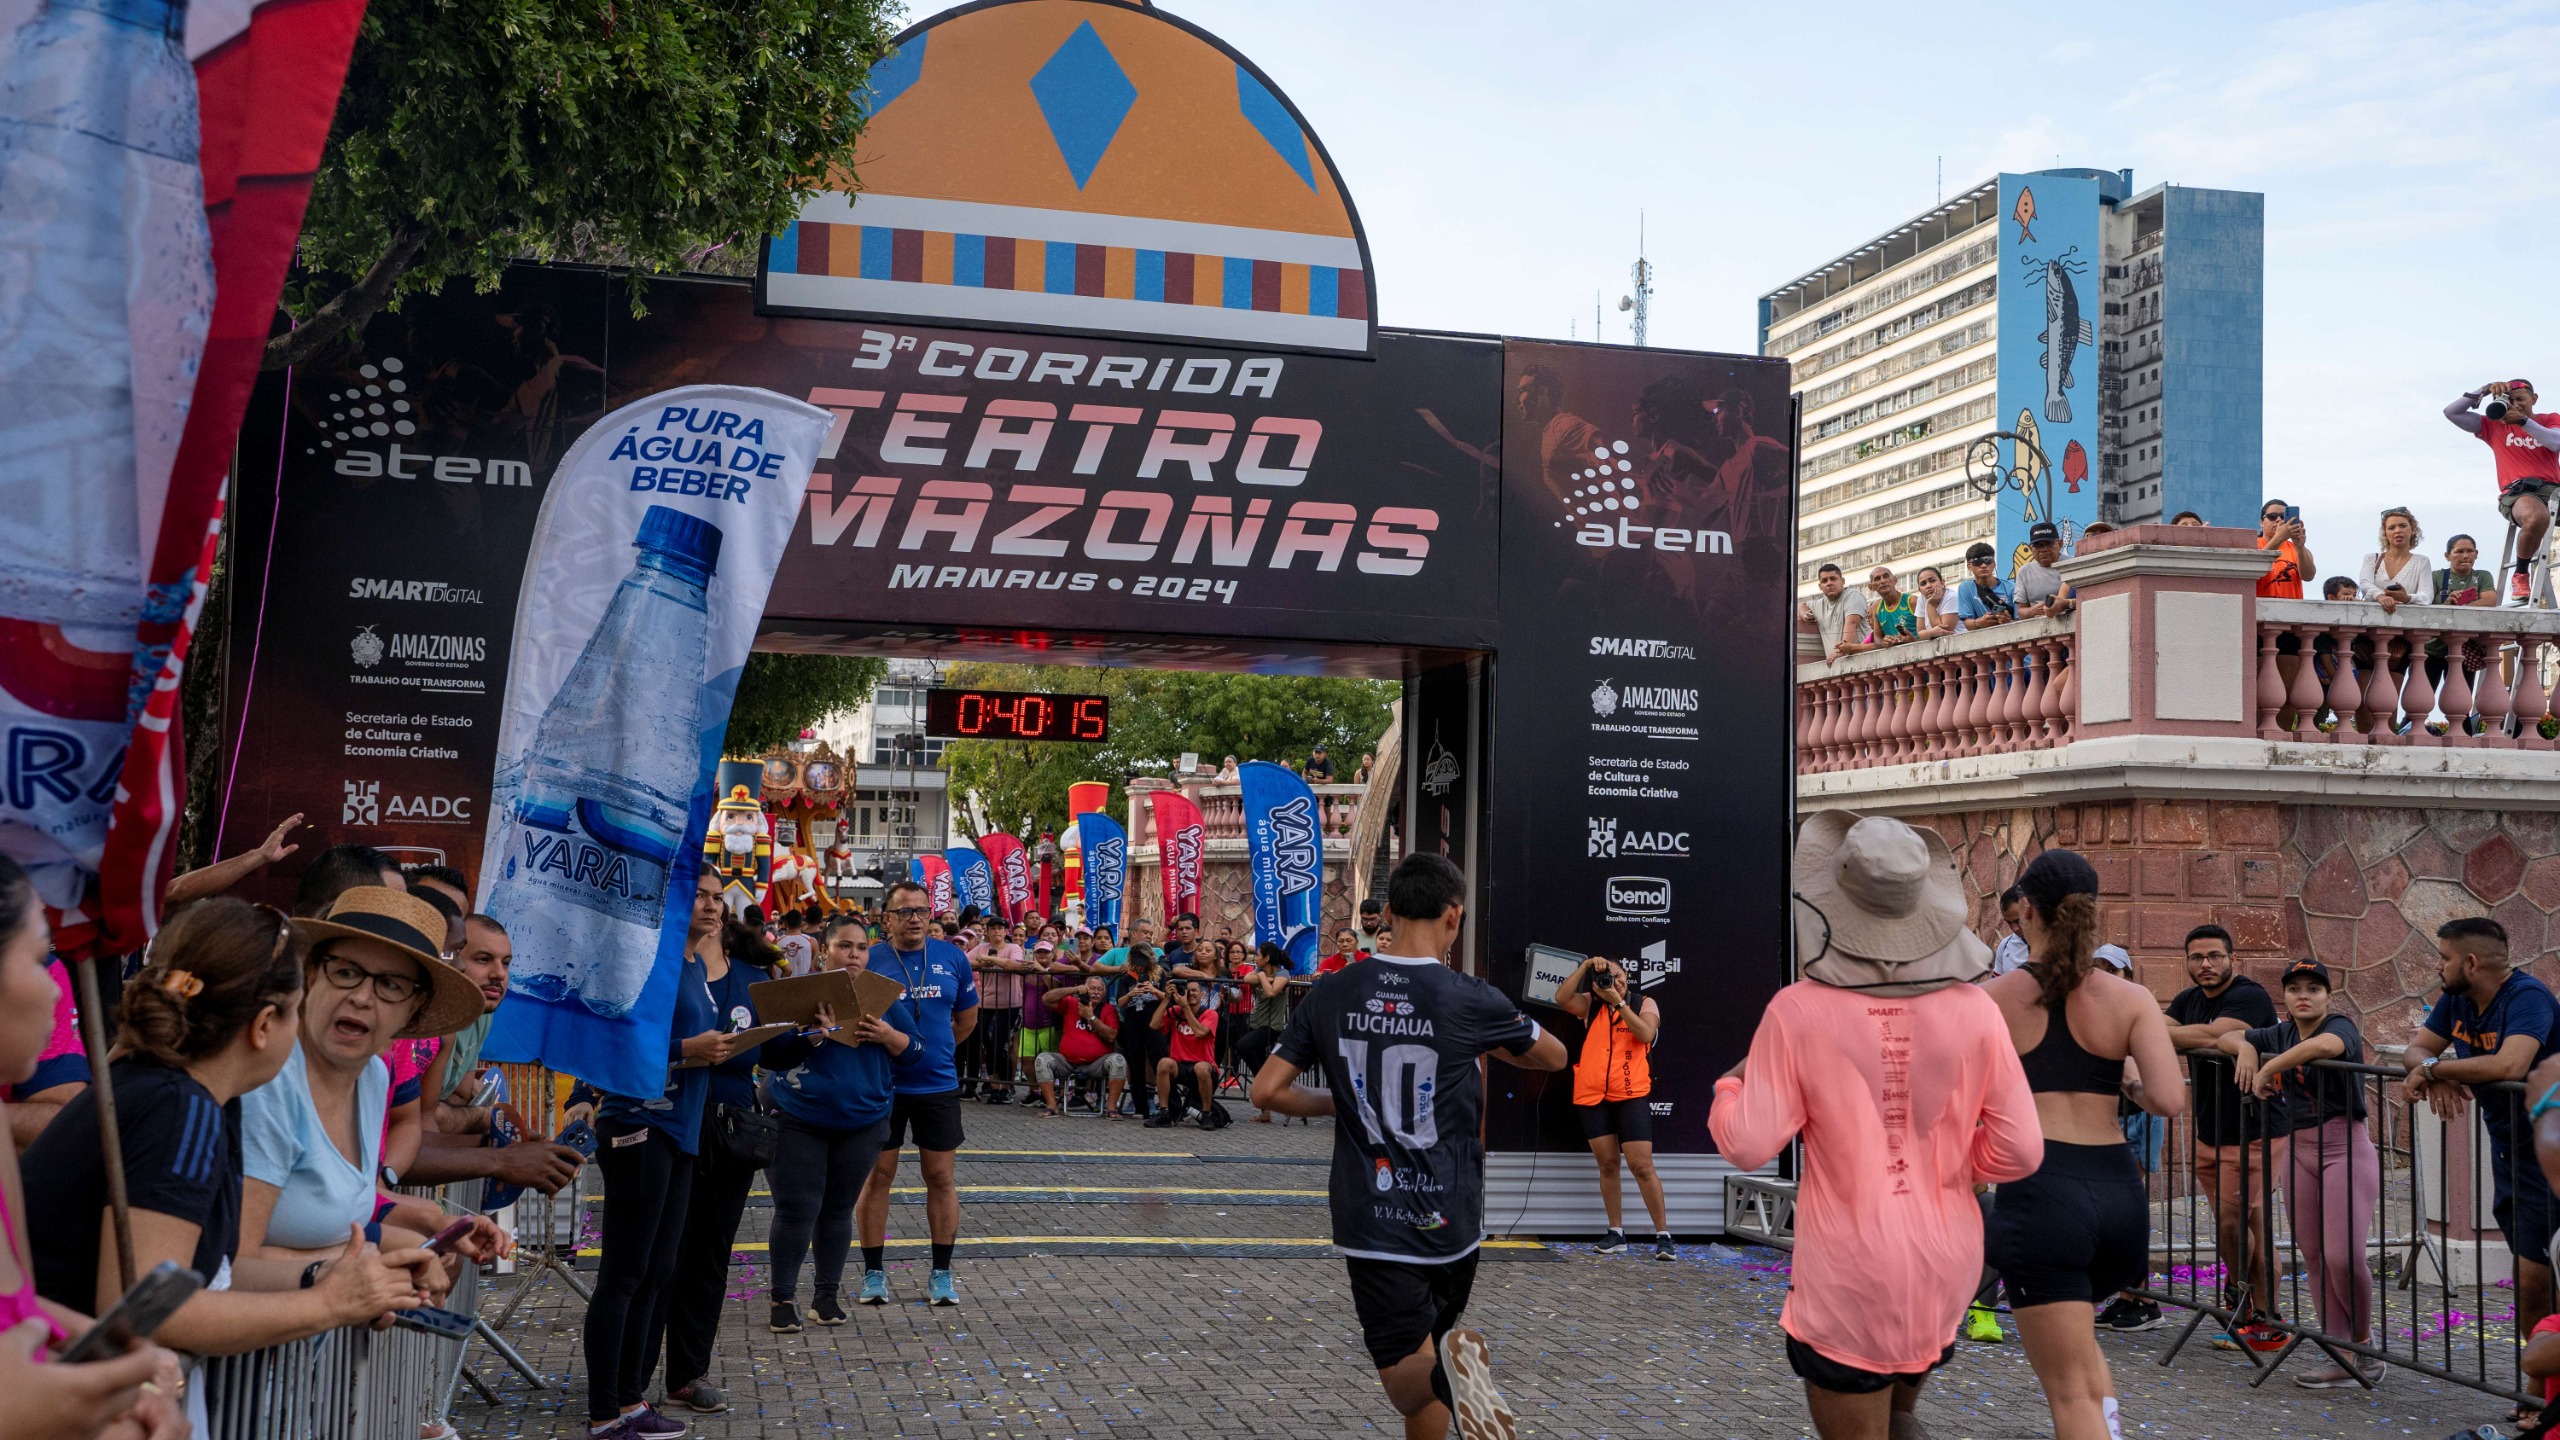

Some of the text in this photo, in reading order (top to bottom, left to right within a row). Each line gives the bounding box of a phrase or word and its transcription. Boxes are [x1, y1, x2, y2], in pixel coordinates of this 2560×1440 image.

[918, 340, 1284, 398] CORRIDA
[656, 406, 764, 445] PURA
[807, 386, 1323, 487] TEATRO
[334, 443, 533, 487] atem
[608, 426, 786, 480] ÁGUA DE
[630, 466, 752, 504] BEBER
[801, 473, 1440, 576] MAZONAS
[1576, 517, 1733, 554] atem
[888, 563, 1238, 604] MANAUS 2024
[389, 633, 486, 662] AMAZONAS
[350, 675, 485, 689] TRABALHO QUE TRANSFORMA
[1621, 686, 1699, 712] AMAZONAS
[346, 711, 473, 727] Secretaria de Estado
[1591, 723, 1699, 735] TRABALHO QUE TRANSFORMA
[345, 728, 422, 742] de Cultura e
[344, 744, 459, 759] Economia Criativa
[1588, 755, 1690, 770] Secretaria de Estado
[1588, 770, 1650, 783] de Cultura e
[1588, 785, 1679, 799] Economia Criativa
[385, 795, 471, 818] AADC
[1271, 798, 1317, 896] YARA
[1621, 830, 1690, 852] AADC
[524, 829, 632, 900] YARA
[1088, 850, 1096, 873] água
[1097, 838, 1123, 902] YARA
[1004, 849, 1029, 905] YARA
[1166, 838, 1178, 913] ÁGUA MINERAL
[1257, 819, 1278, 944] água mineral natu
[934, 870, 952, 912] YARA
[1090, 875, 1098, 911] mineral
[1611, 885, 1666, 905] bemol
[1605, 915, 1628, 923] Escolha
[1641, 916, 1671, 925] Confiança
[1535, 970, 1568, 985] SMAR
[1641, 957, 1681, 973] Brasil
[1375, 990, 1409, 1001] GUARANÁ
[1346, 1012, 1435, 1038] TUCHAUA
[1338, 1037, 1440, 1150] 10
[1395, 1171, 1444, 1193] São Pedro
[1374, 1205, 1383, 1219] V.
[1385, 1206, 1394, 1220] V.
